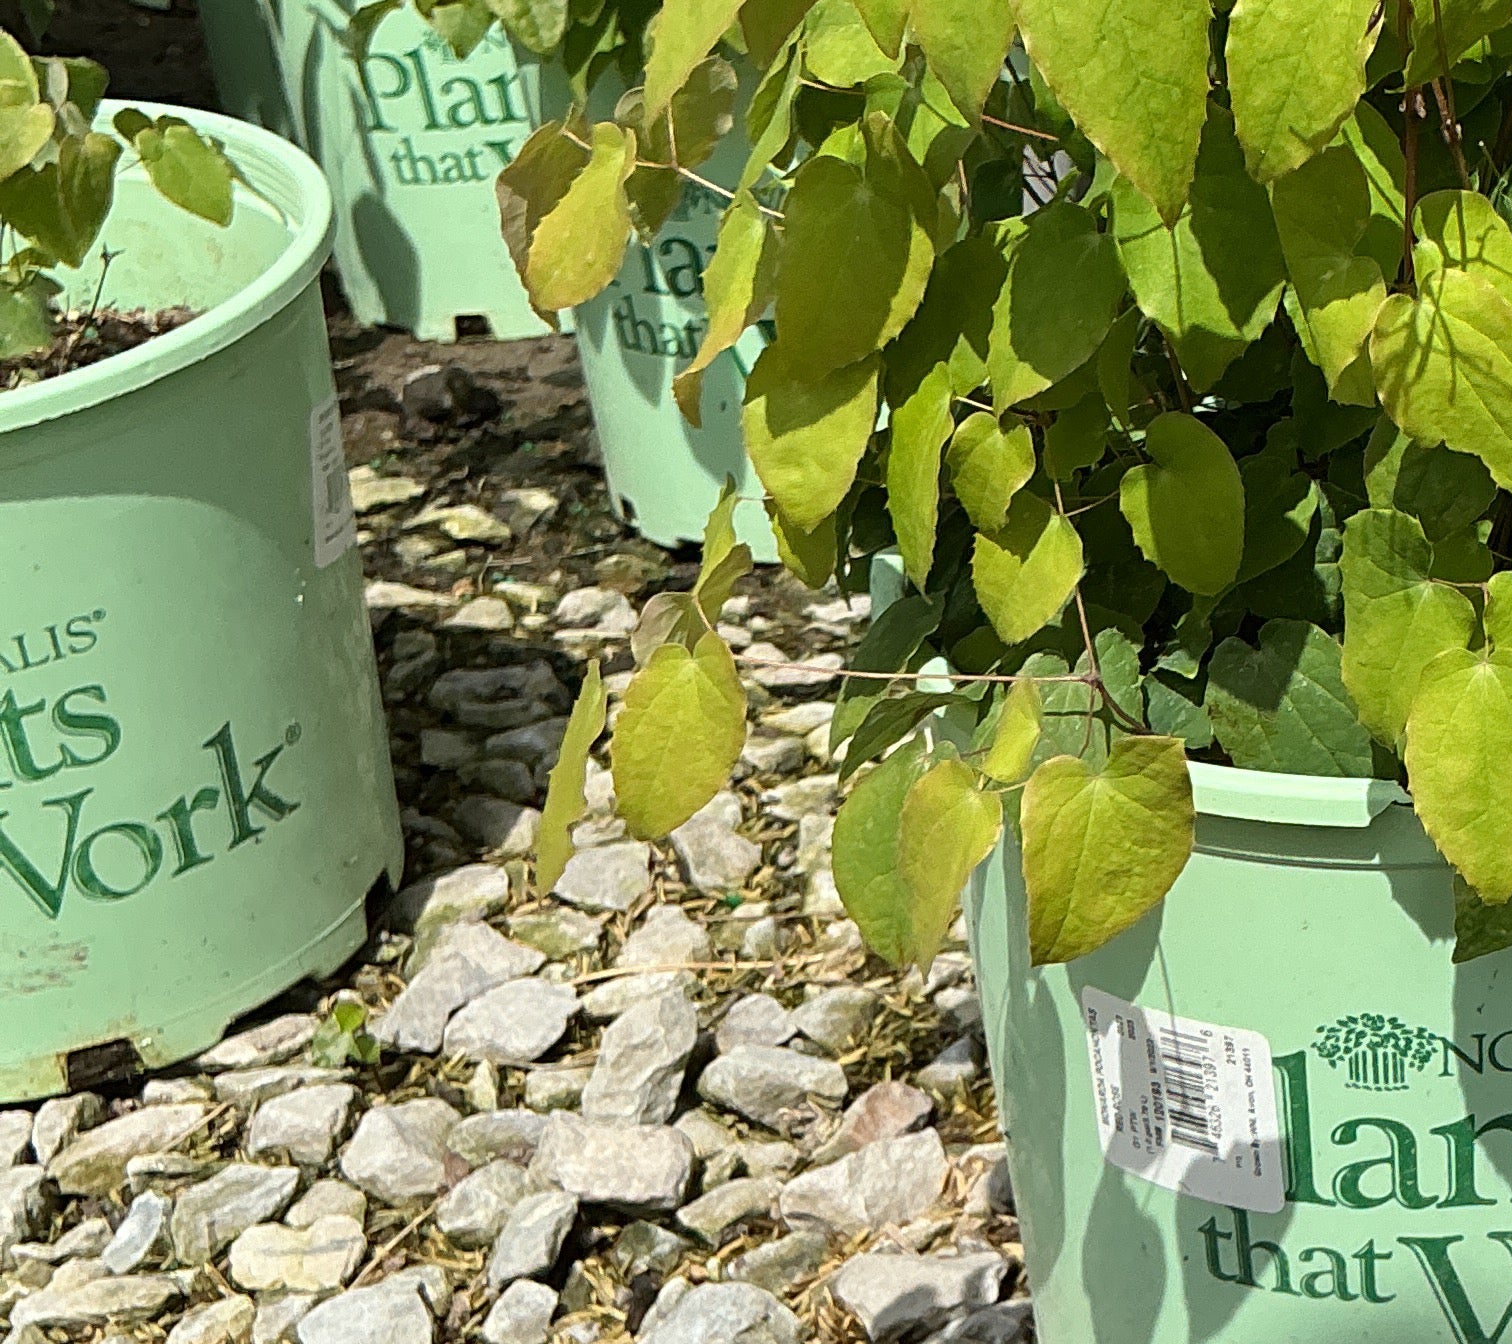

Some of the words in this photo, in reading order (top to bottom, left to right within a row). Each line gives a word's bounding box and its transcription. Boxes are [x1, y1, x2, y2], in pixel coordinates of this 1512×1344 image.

[391, 136, 489, 185] that
[0, 684, 121, 782] ts
[1199, 1027, 1213, 1038] 6
[1198, 1208, 1396, 1304] that
